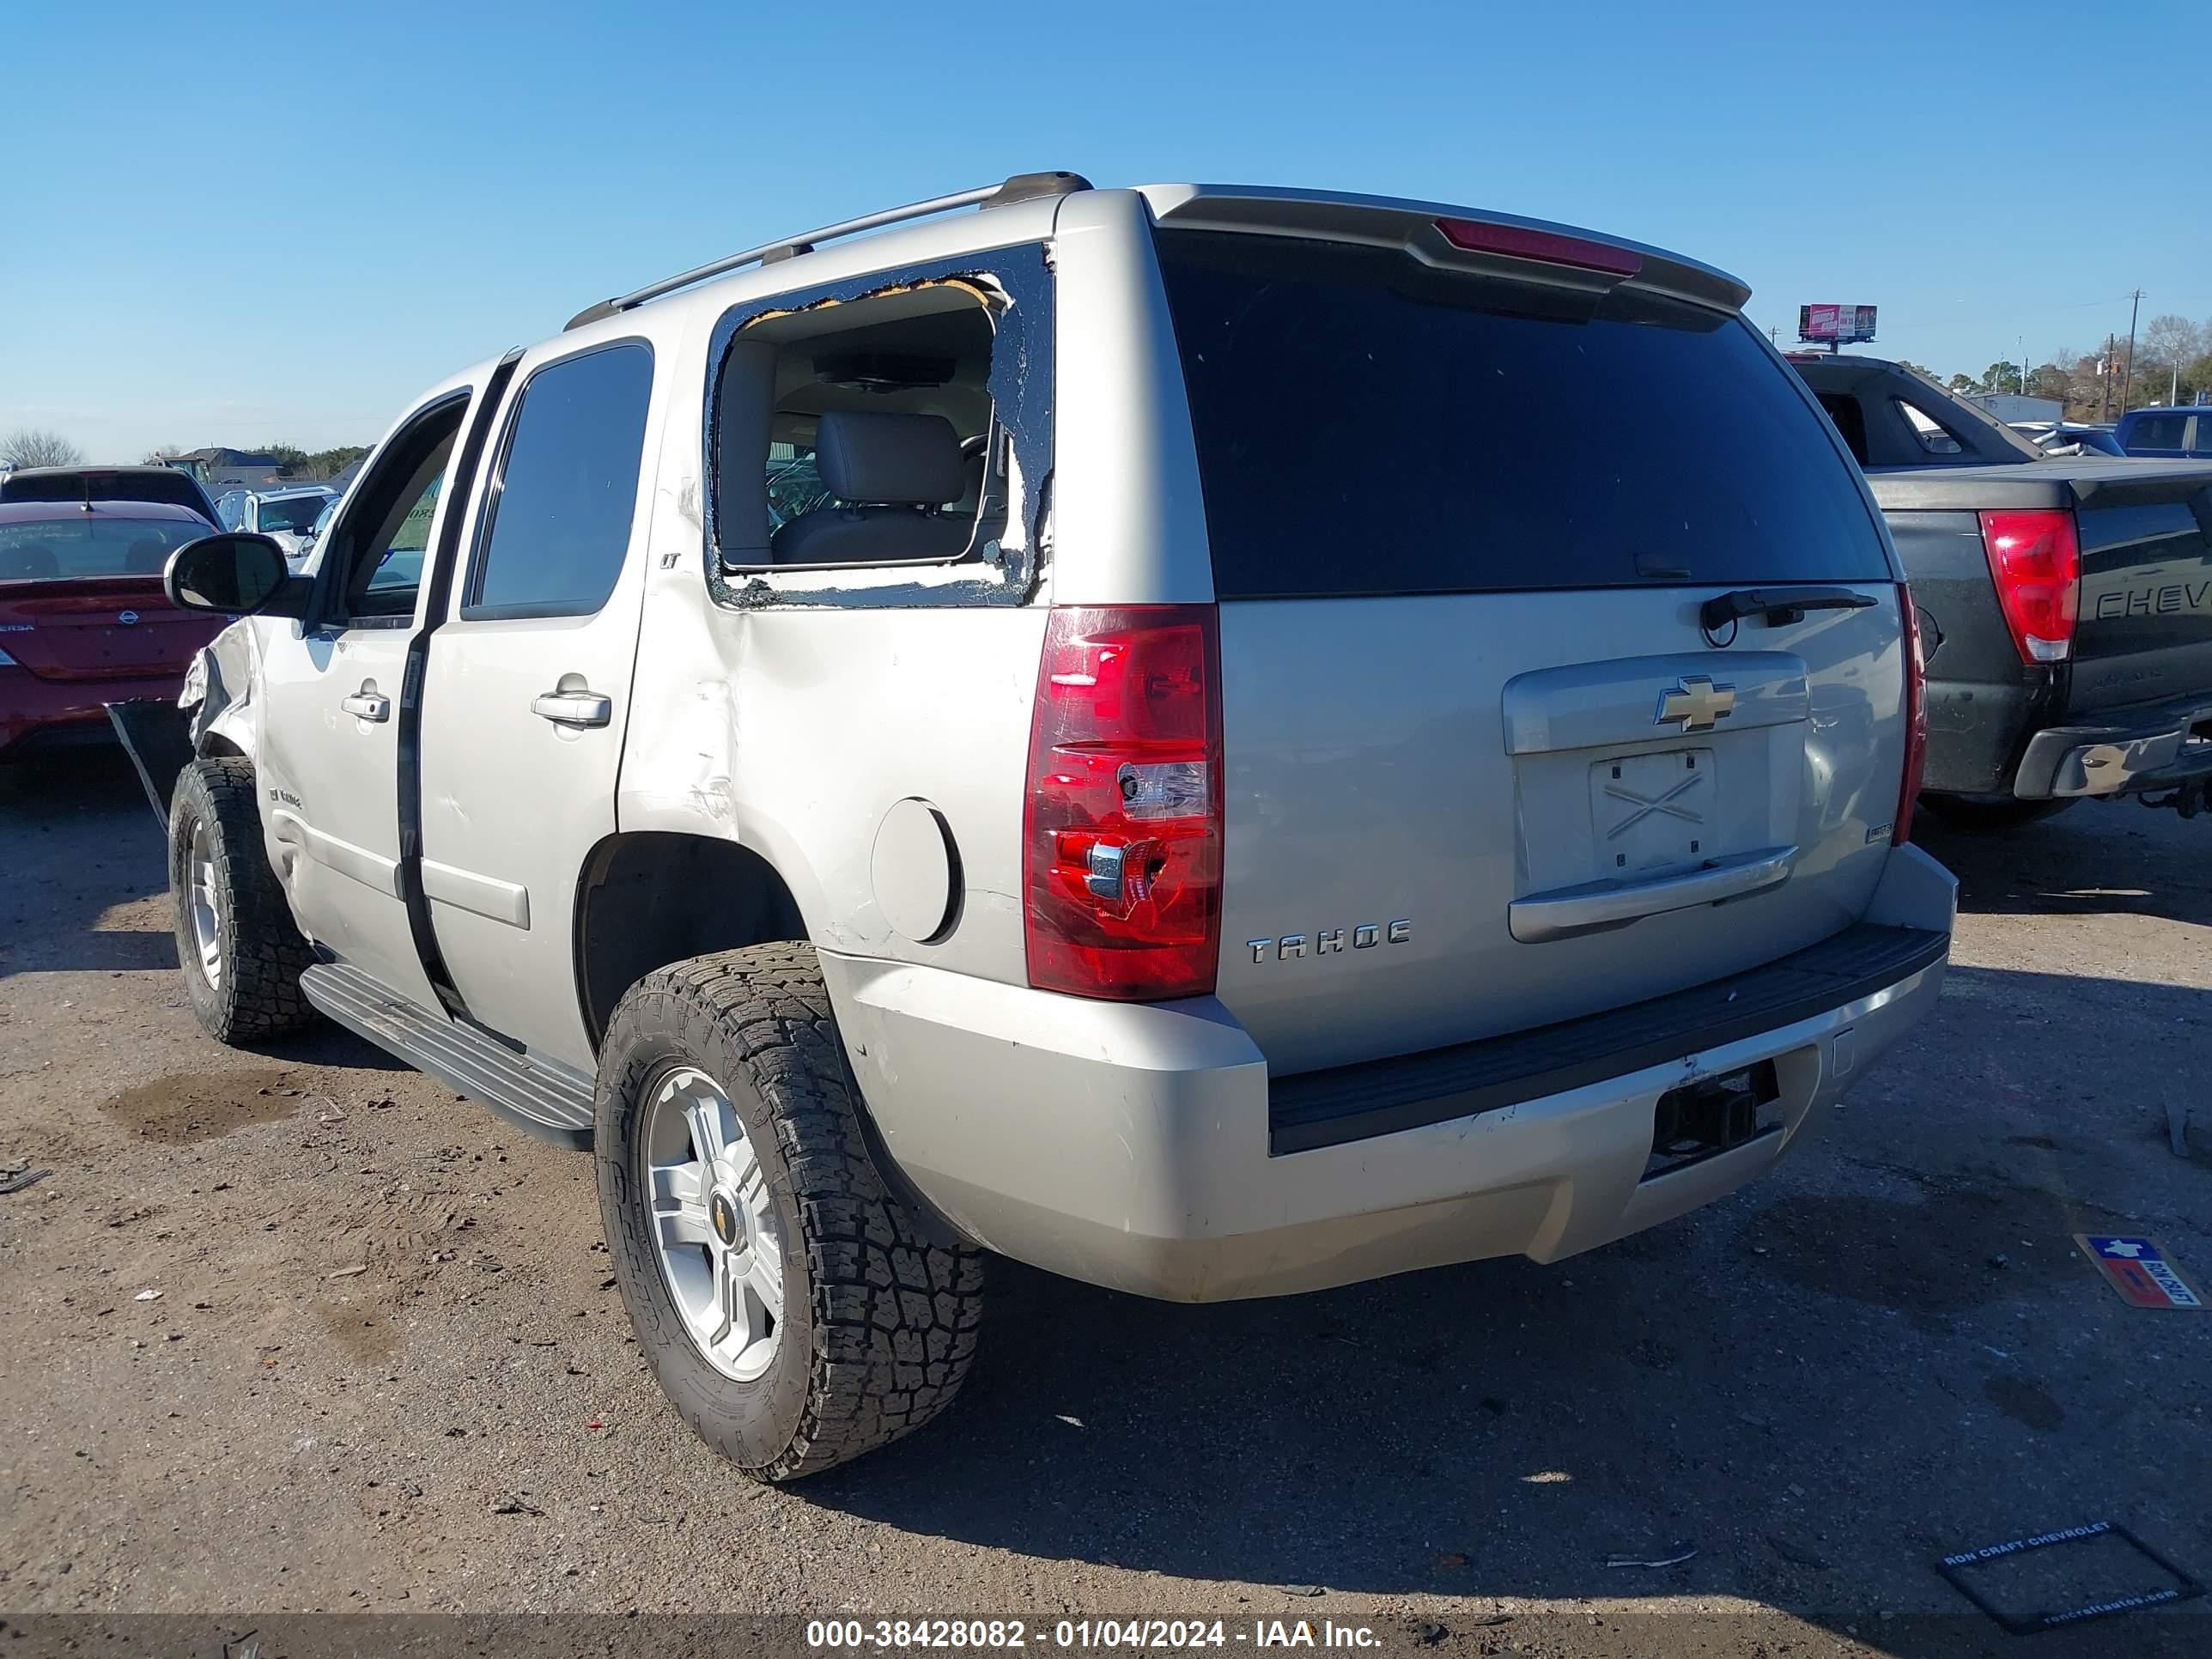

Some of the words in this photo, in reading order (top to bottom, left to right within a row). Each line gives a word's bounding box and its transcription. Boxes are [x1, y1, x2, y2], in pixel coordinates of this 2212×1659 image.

[659, 552, 682, 570] LT
[1246, 919, 1411, 964] TAHOE
[1944, 1553, 1977, 1566] RON
[1979, 1541, 2025, 1558] CRAFT
[2027, 1522, 2111, 1546] CHEVROLET
[2044, 1589, 2179, 1624] roncraftautos.com
